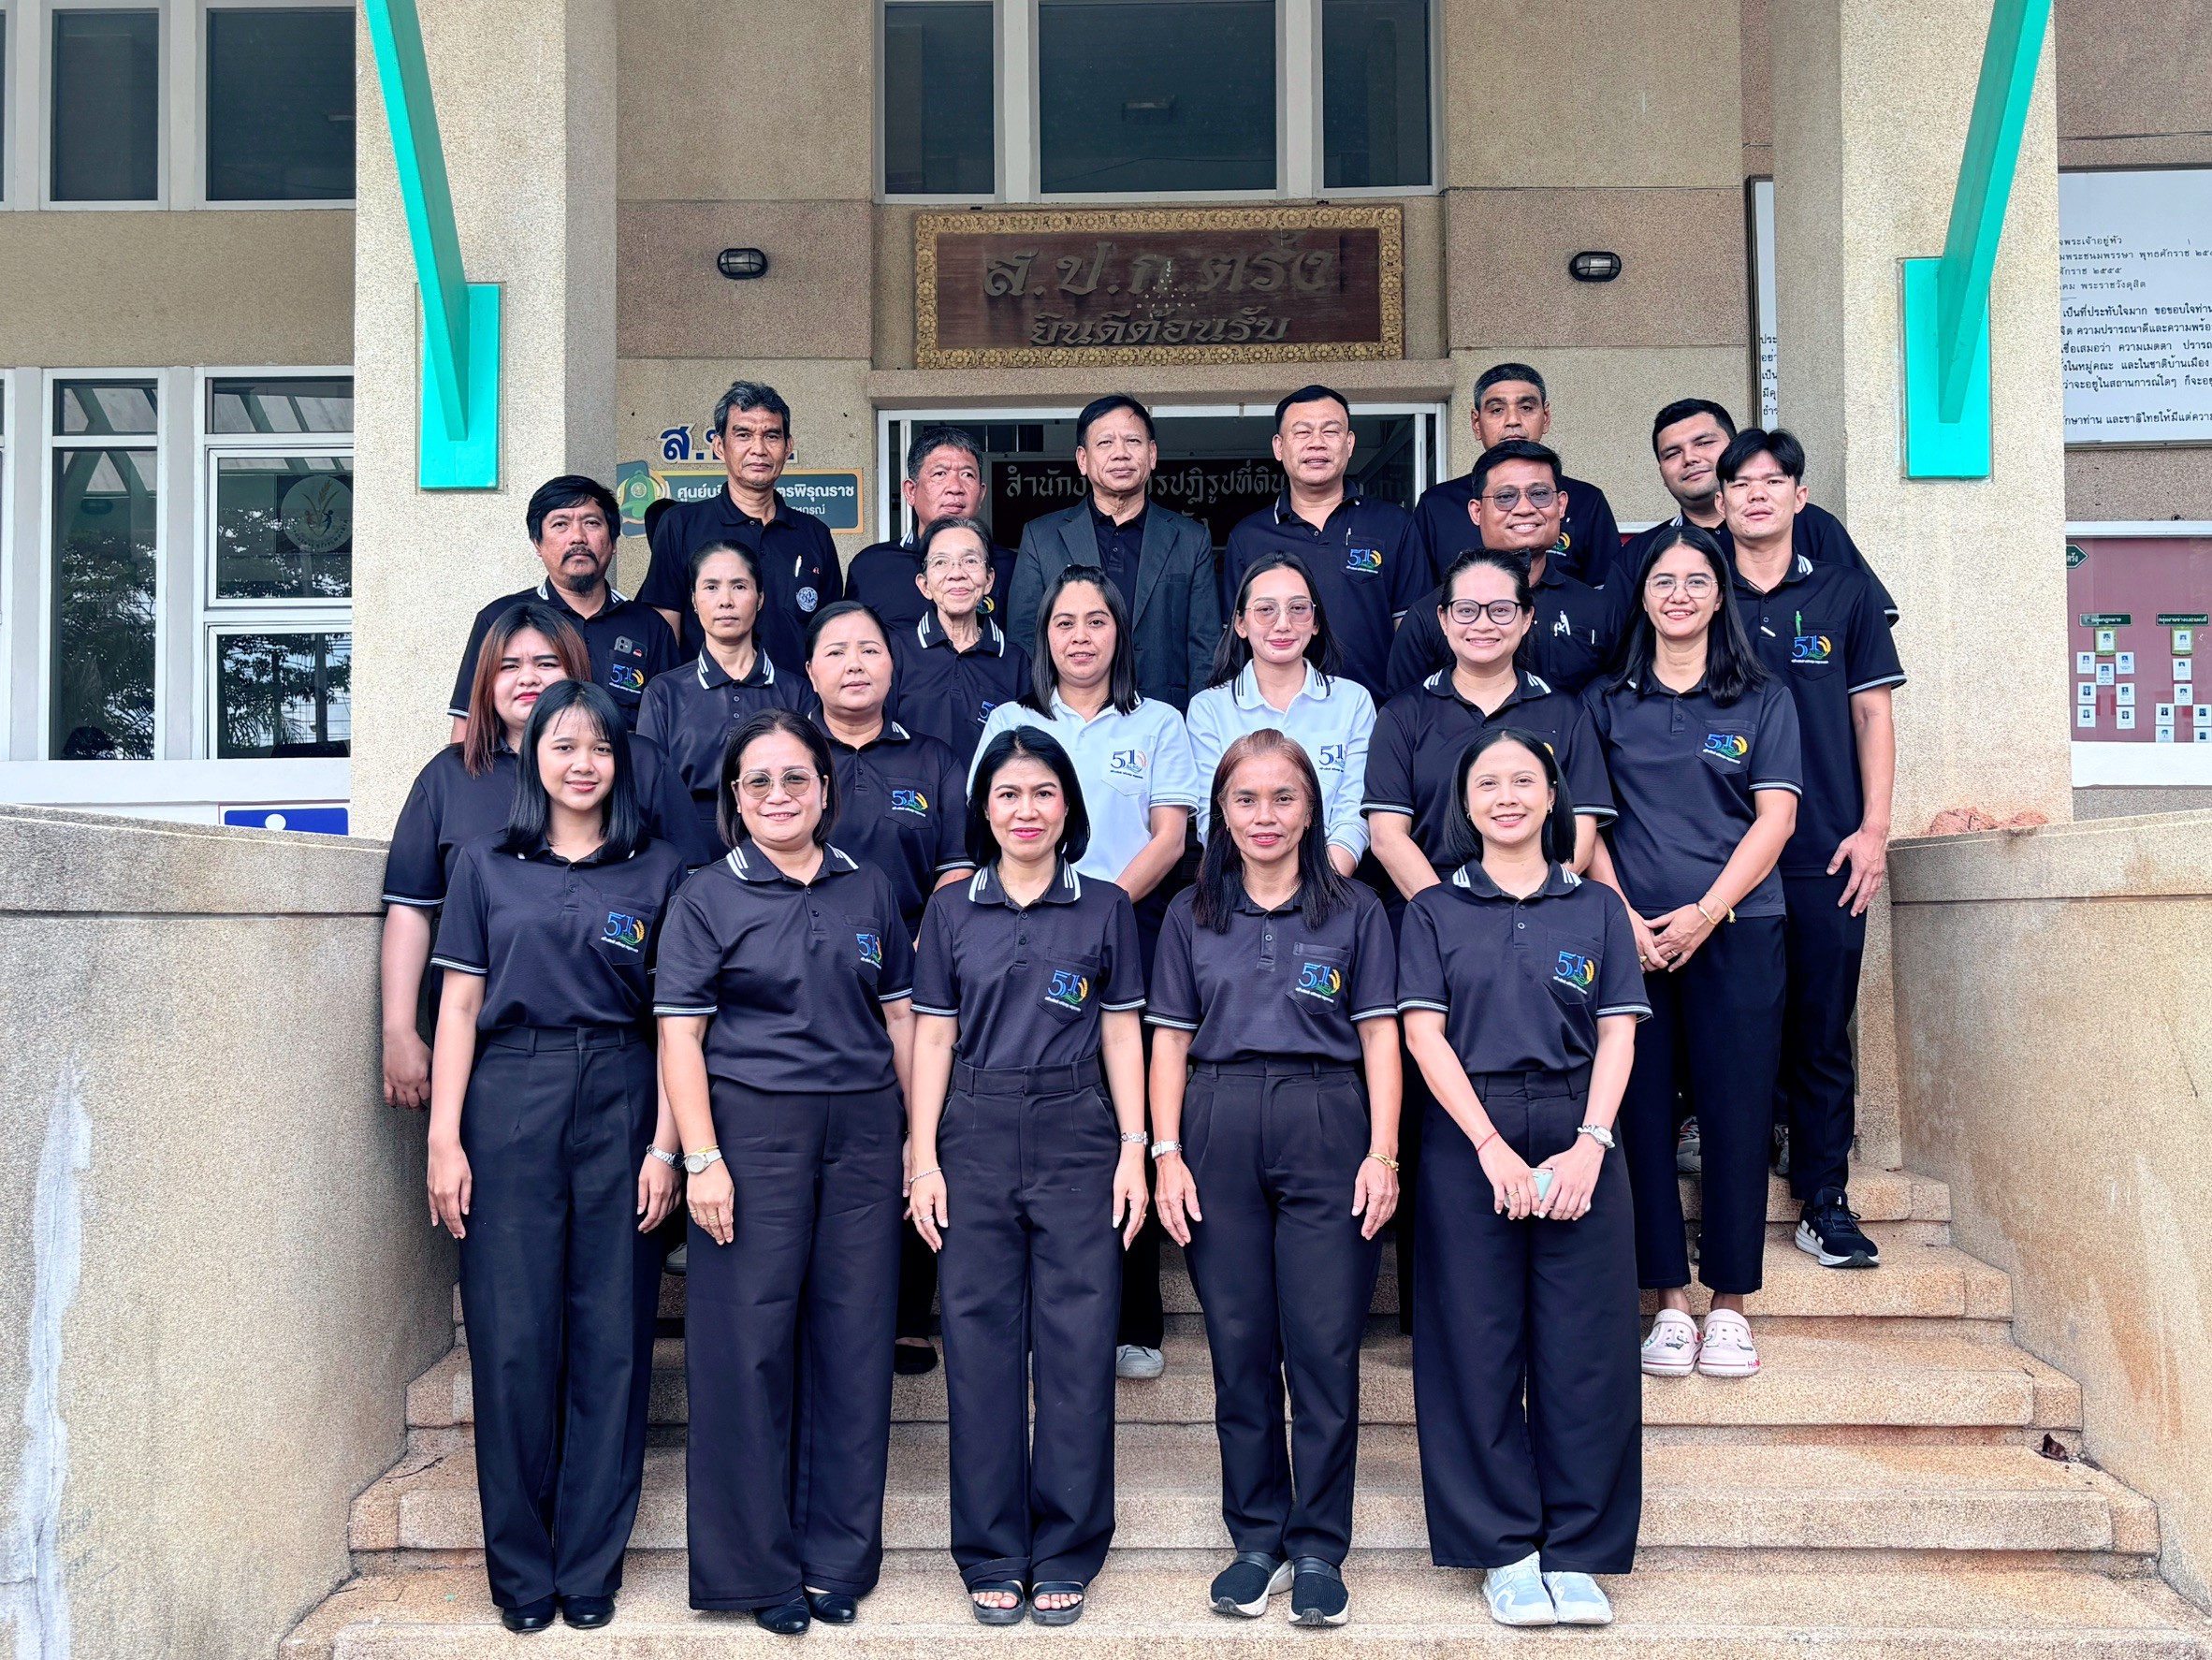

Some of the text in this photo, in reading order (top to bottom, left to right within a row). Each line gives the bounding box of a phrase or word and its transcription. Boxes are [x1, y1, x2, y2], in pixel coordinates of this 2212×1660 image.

[1029, 306, 1291, 345] ยินดีต้อนรับ
[2076, 318, 2212, 335] ความปรารถนาดีและความพร้อ
[1347, 548, 1371, 568] 51
[1793, 635, 1818, 657] 51
[610, 663, 633, 683] 51
[1705, 733, 1734, 751] 51
[1111, 749, 1136, 769] 51
[1320, 744, 1344, 765] 51
[892, 790, 916, 808] 51
[604, 911, 633, 939] 51
[856, 933, 877, 958] 51
[1555, 951, 1584, 977] 51
[1048, 969, 1080, 997] 51
[1299, 963, 1331, 989] 51
